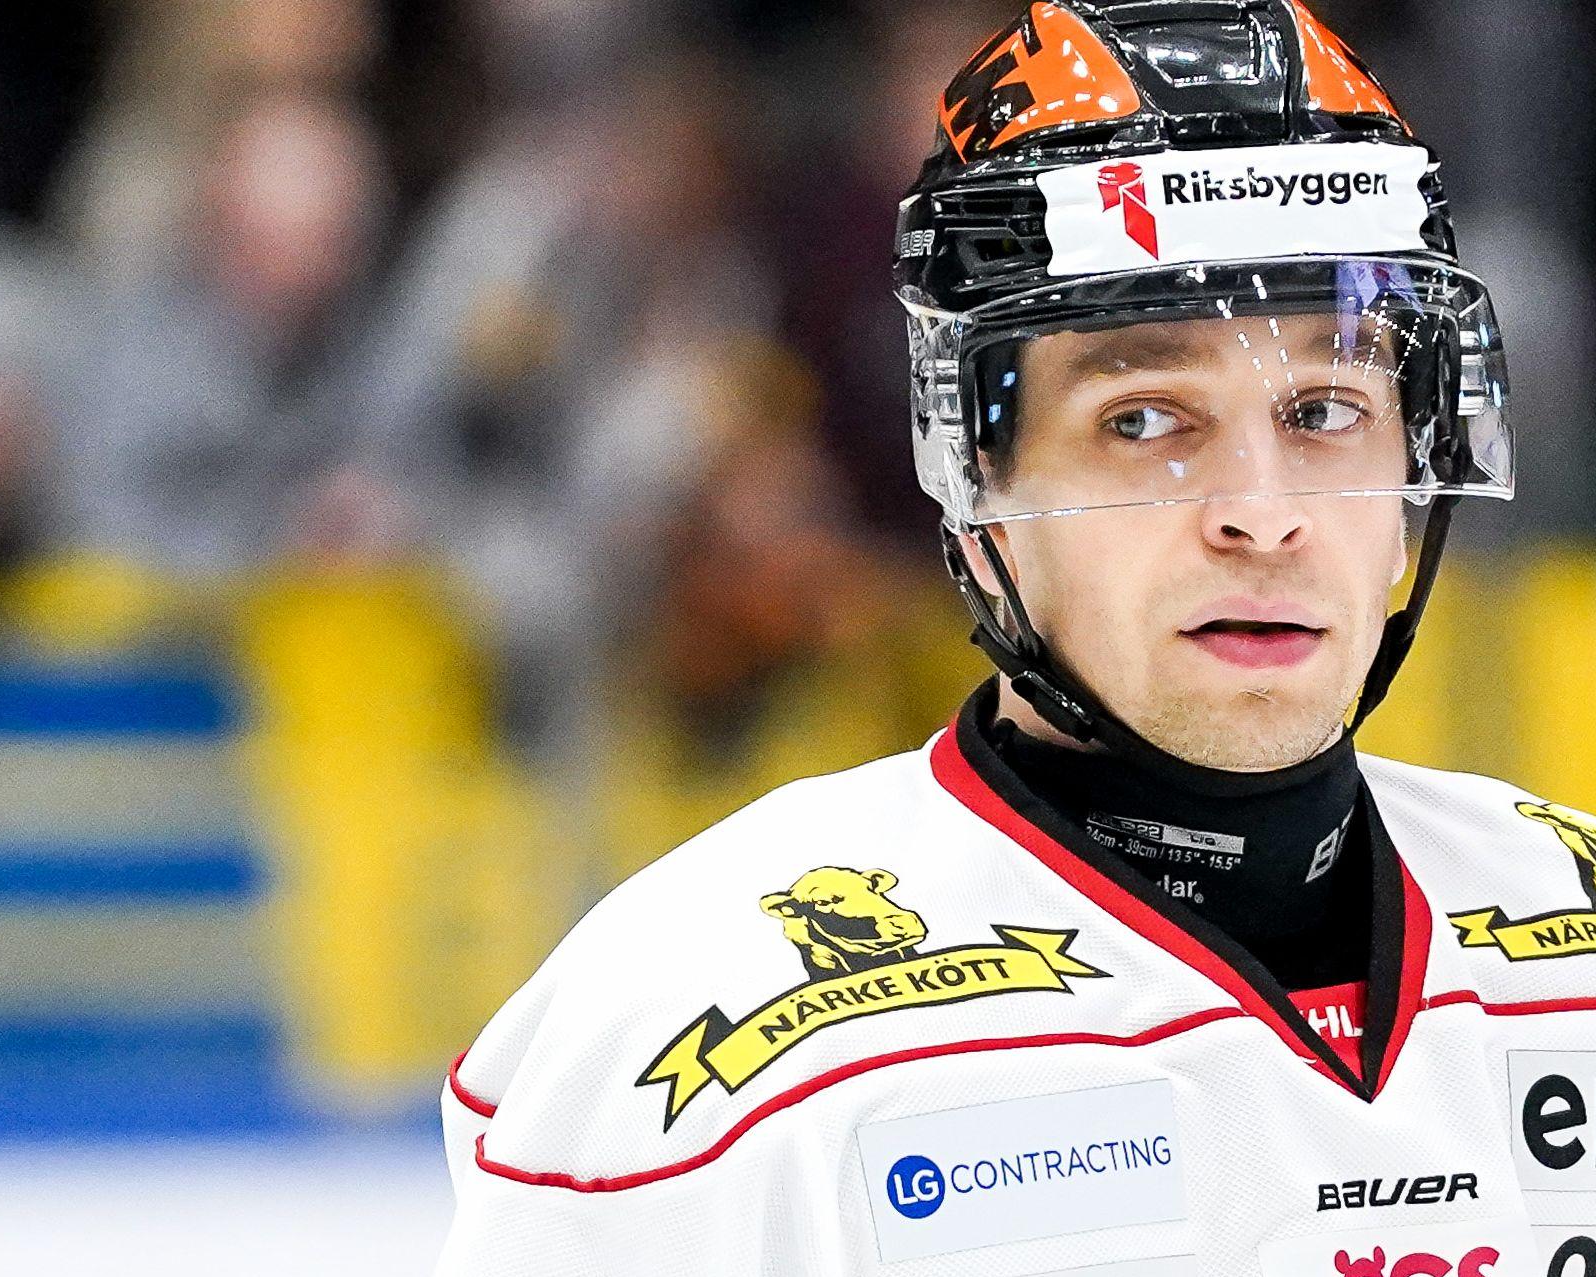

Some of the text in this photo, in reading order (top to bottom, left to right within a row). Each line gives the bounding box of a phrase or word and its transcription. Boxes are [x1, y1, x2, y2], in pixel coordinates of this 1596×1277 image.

[1161, 166, 1390, 207] Riksbyggen
[758, 957, 1011, 1046] NÄRKE KÖTT
[892, 1135, 1172, 1206] LG CONTRACTING
